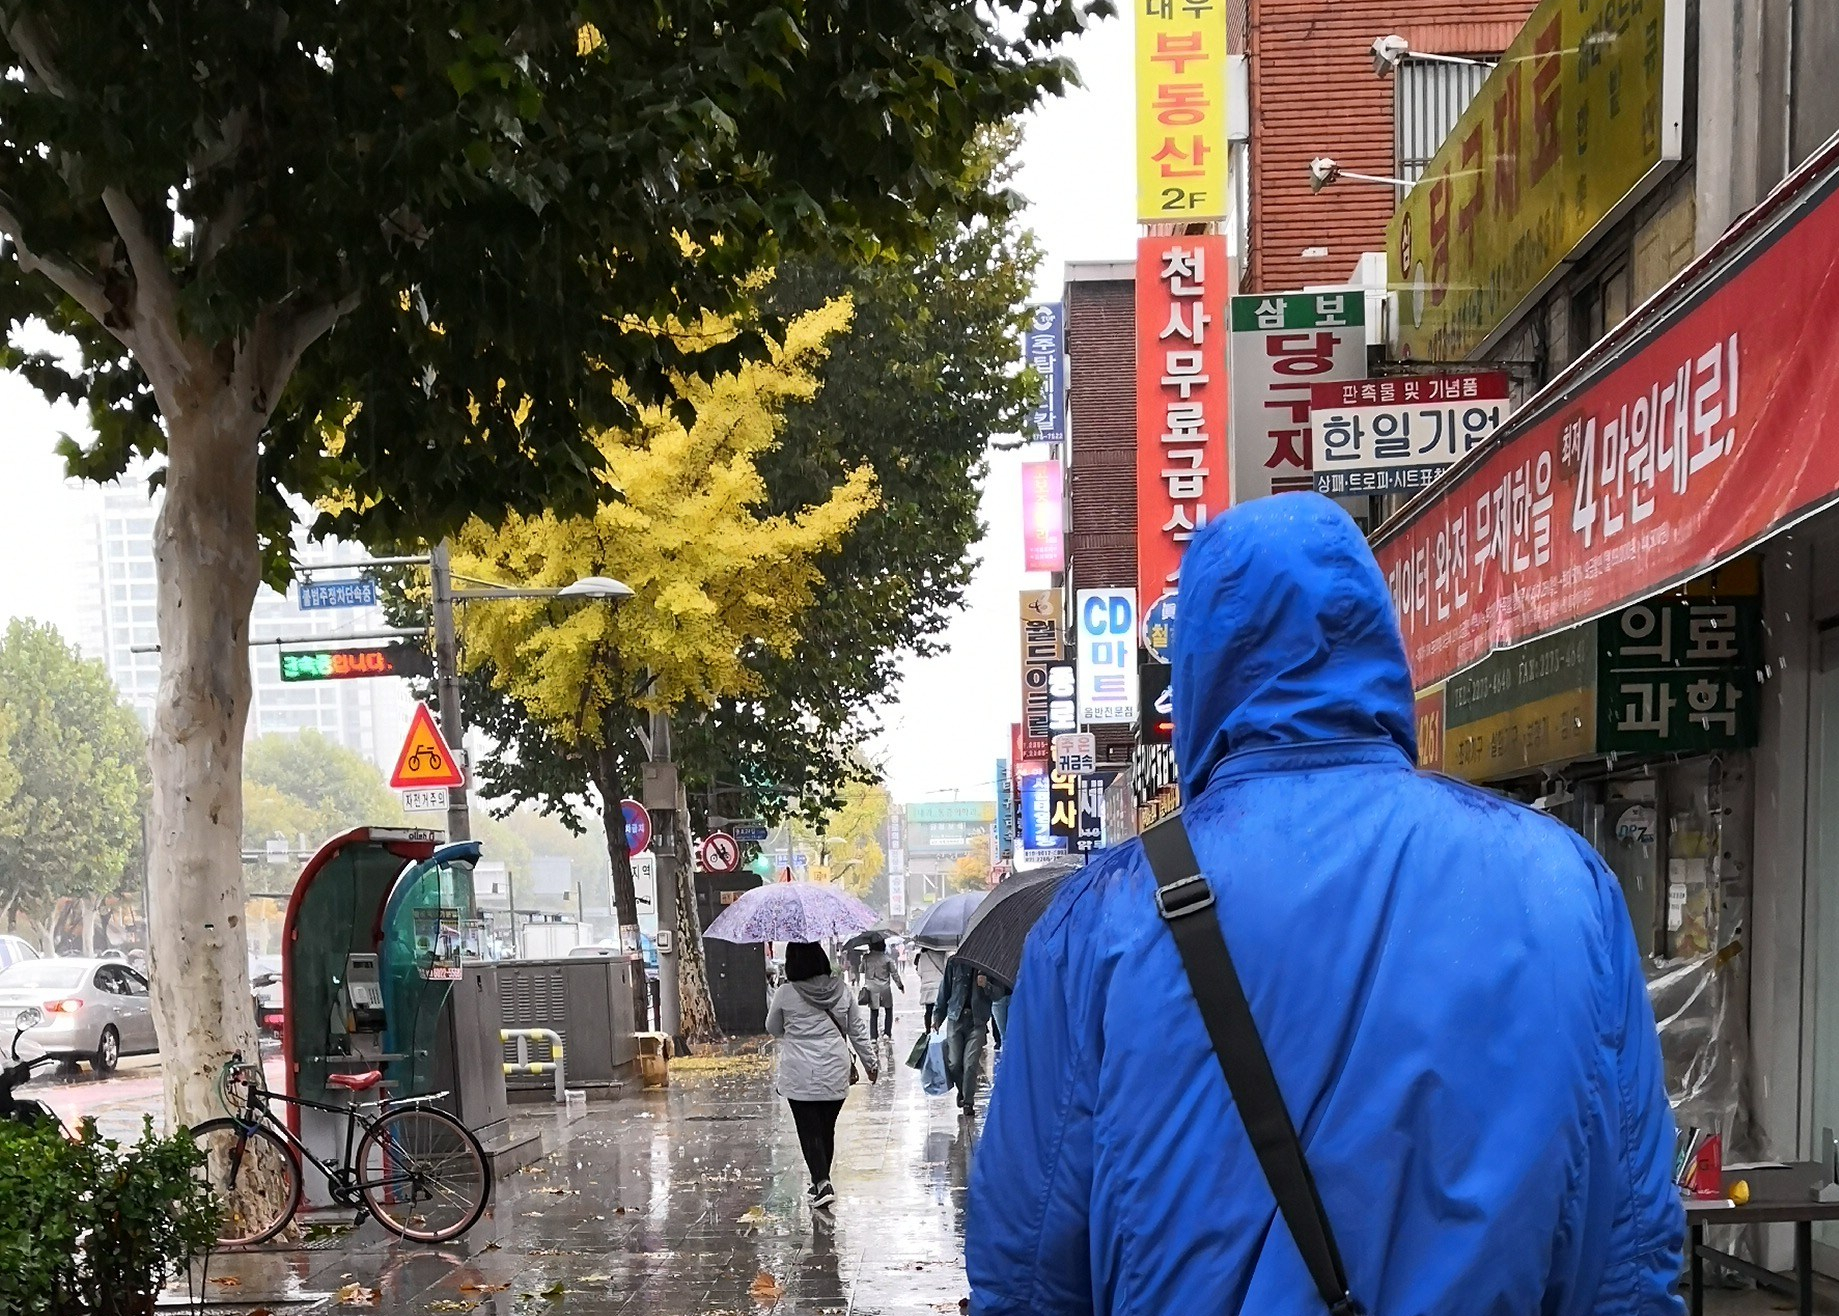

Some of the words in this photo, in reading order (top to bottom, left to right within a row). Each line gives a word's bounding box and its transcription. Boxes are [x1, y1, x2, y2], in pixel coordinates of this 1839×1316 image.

[1151, 31, 1210, 178] 부동산
[1161, 187, 1207, 210] 2F
[1343, 383, 1395, 405] 판촉물
[1405, 381, 1420, 401] 및
[1429, 377, 1478, 399] 기념품
[1159, 246, 1212, 596] 천사무료급식
[1323, 406, 1500, 462] 한일기업
[1436, 507, 1468, 622] 완전
[1475, 450, 1554, 594] 무제한을
[1084, 596, 1131, 635] CD
[1620, 605, 1738, 662] 의료
[1084, 706, 1133, 719] 음반전문점
[1617, 679, 1743, 739] 과학
[1060, 755, 1092, 770] 귀금속
[406, 791, 445, 808] 자전거주의
